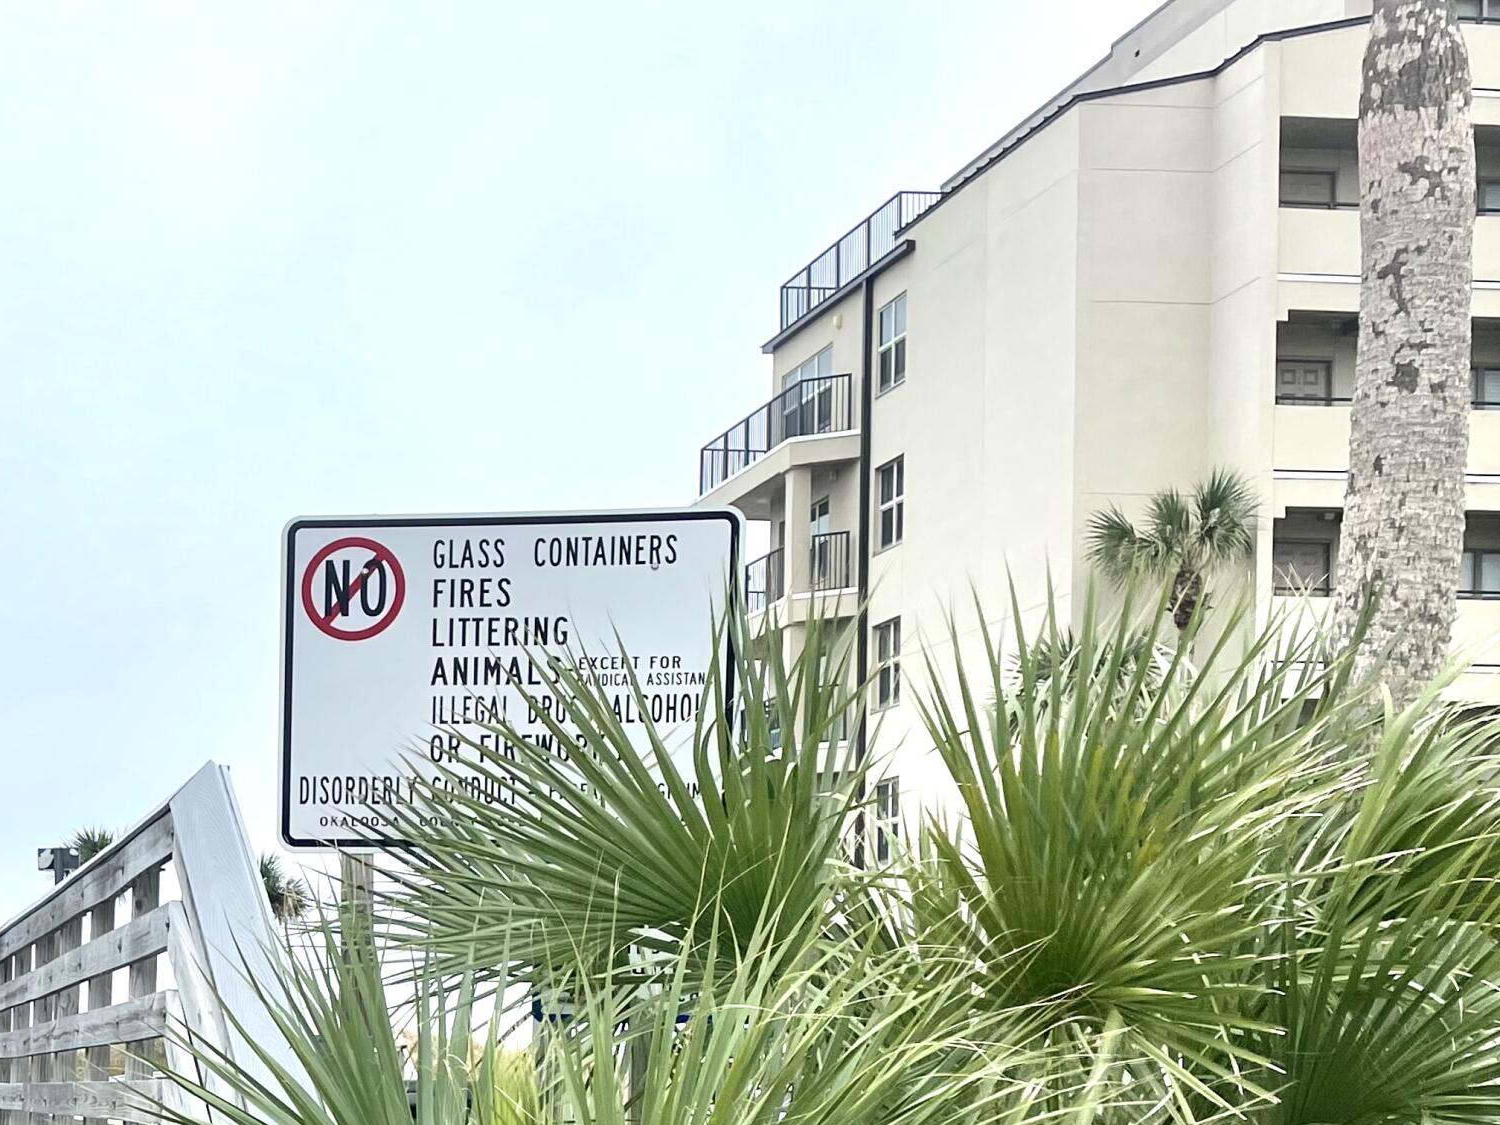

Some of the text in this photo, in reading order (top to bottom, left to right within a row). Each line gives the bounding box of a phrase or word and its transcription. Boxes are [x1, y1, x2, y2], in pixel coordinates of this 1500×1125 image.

[433, 534, 679, 569] GLASS CONTAINERS
[324, 559, 387, 618] NO
[432, 578, 512, 608] FIRES
[431, 616, 569, 647] LITTERING
[650, 655, 682, 669] FOR
[576, 671, 712, 687] ADICA ASSISTAN
[432, 695, 509, 725] ILLEGAL
[528, 694, 592, 724] DRU
[430, 734, 461, 763] OR
[299, 775, 419, 805] DISORDERLY
